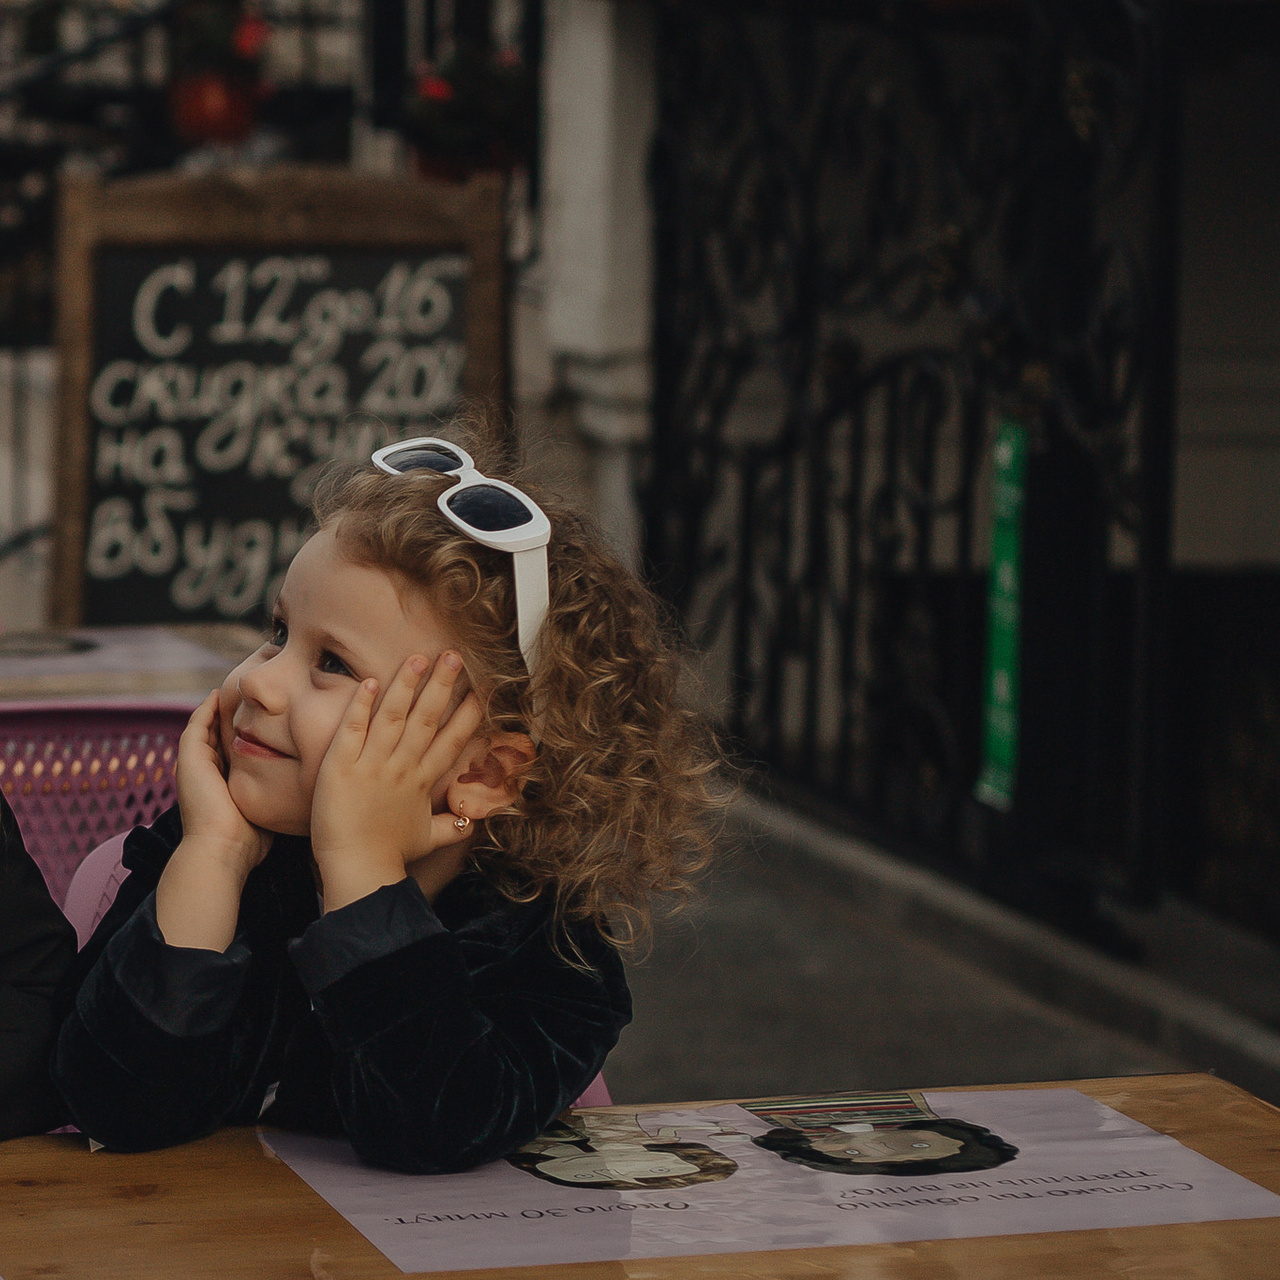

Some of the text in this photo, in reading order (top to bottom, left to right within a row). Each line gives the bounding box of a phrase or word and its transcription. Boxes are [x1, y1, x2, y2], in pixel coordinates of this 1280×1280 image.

[836, 1181, 1194, 1211] Сколько ты обычно
[838, 1169, 1157, 1199] тратишь на вино?
[384, 1200, 690, 1225] Около 30 минут.
